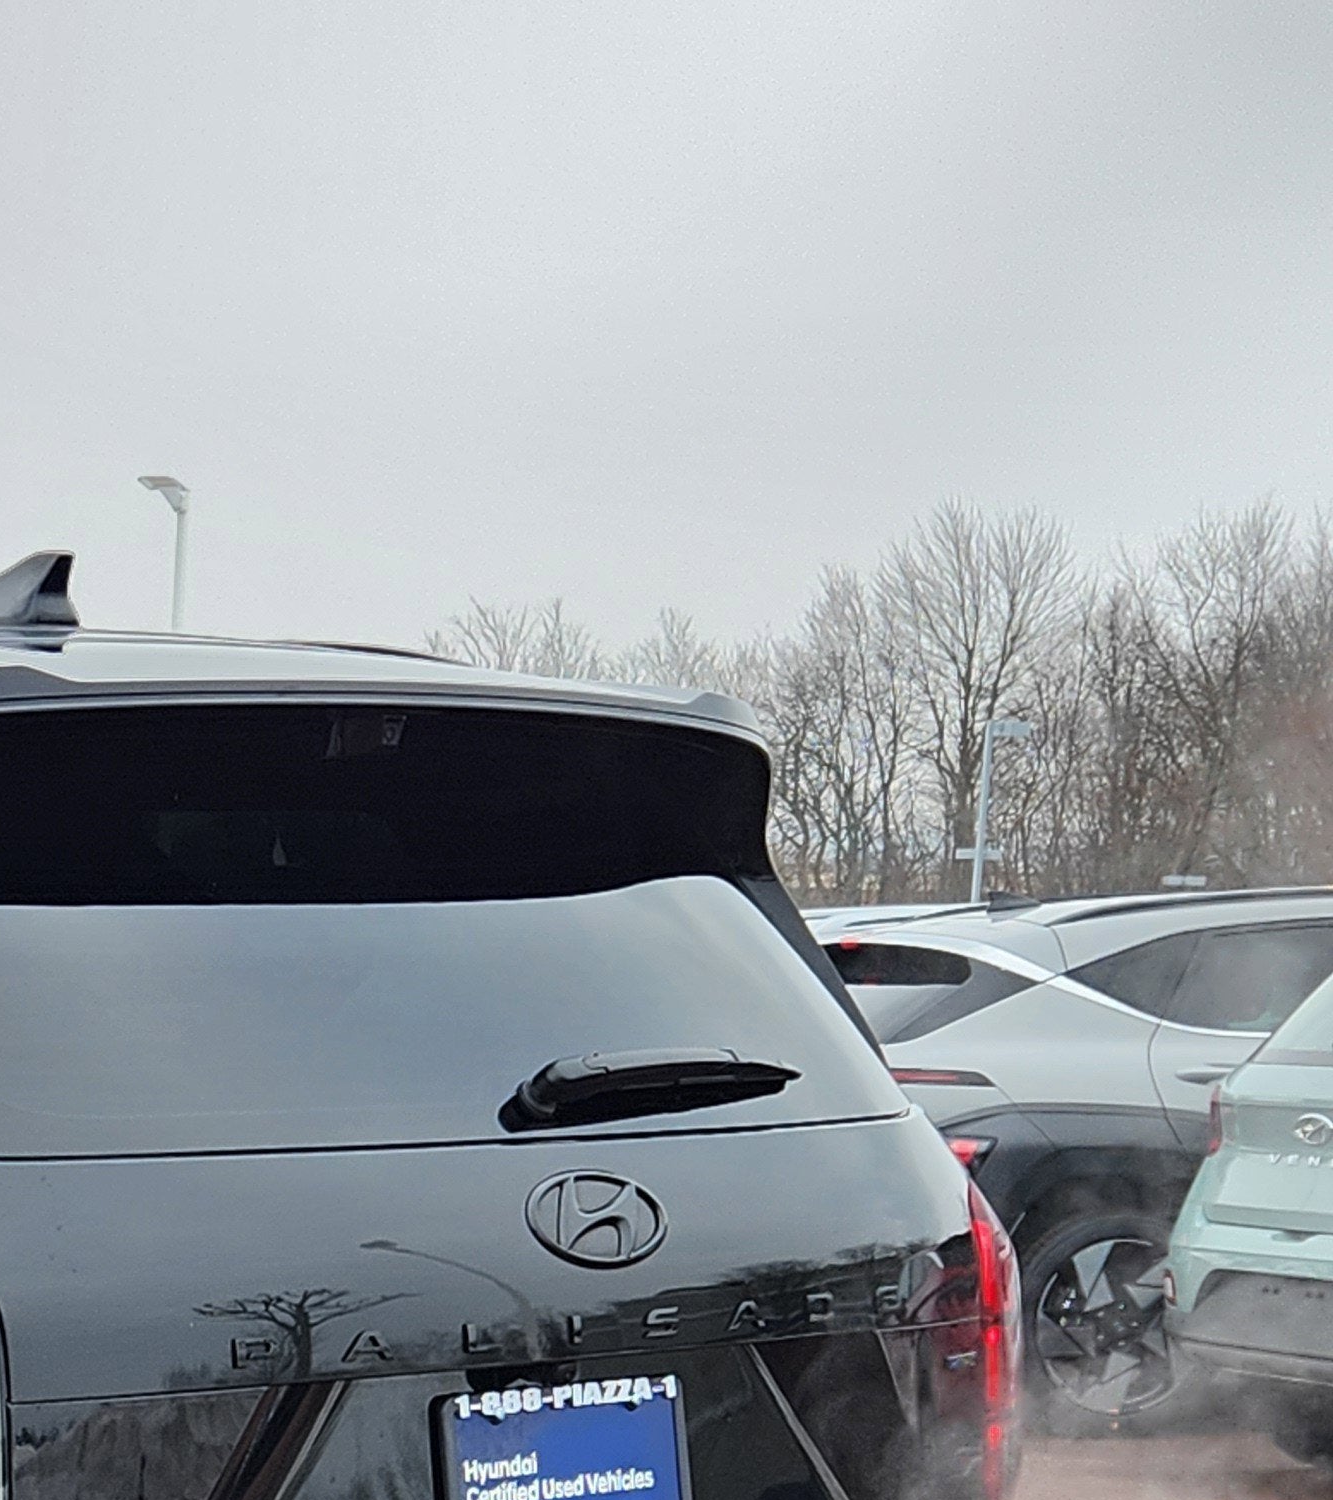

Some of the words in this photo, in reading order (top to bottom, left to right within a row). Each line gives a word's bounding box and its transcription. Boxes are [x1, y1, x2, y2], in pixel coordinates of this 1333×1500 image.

[1268, 1153, 1333, 1167] VEN
[231, 1285, 905, 1370] PALISADE
[463, 1452, 538, 1486] Hyundai
[542, 1474, 583, 1500] Used
[586, 1468, 655, 1495] Vehicles
